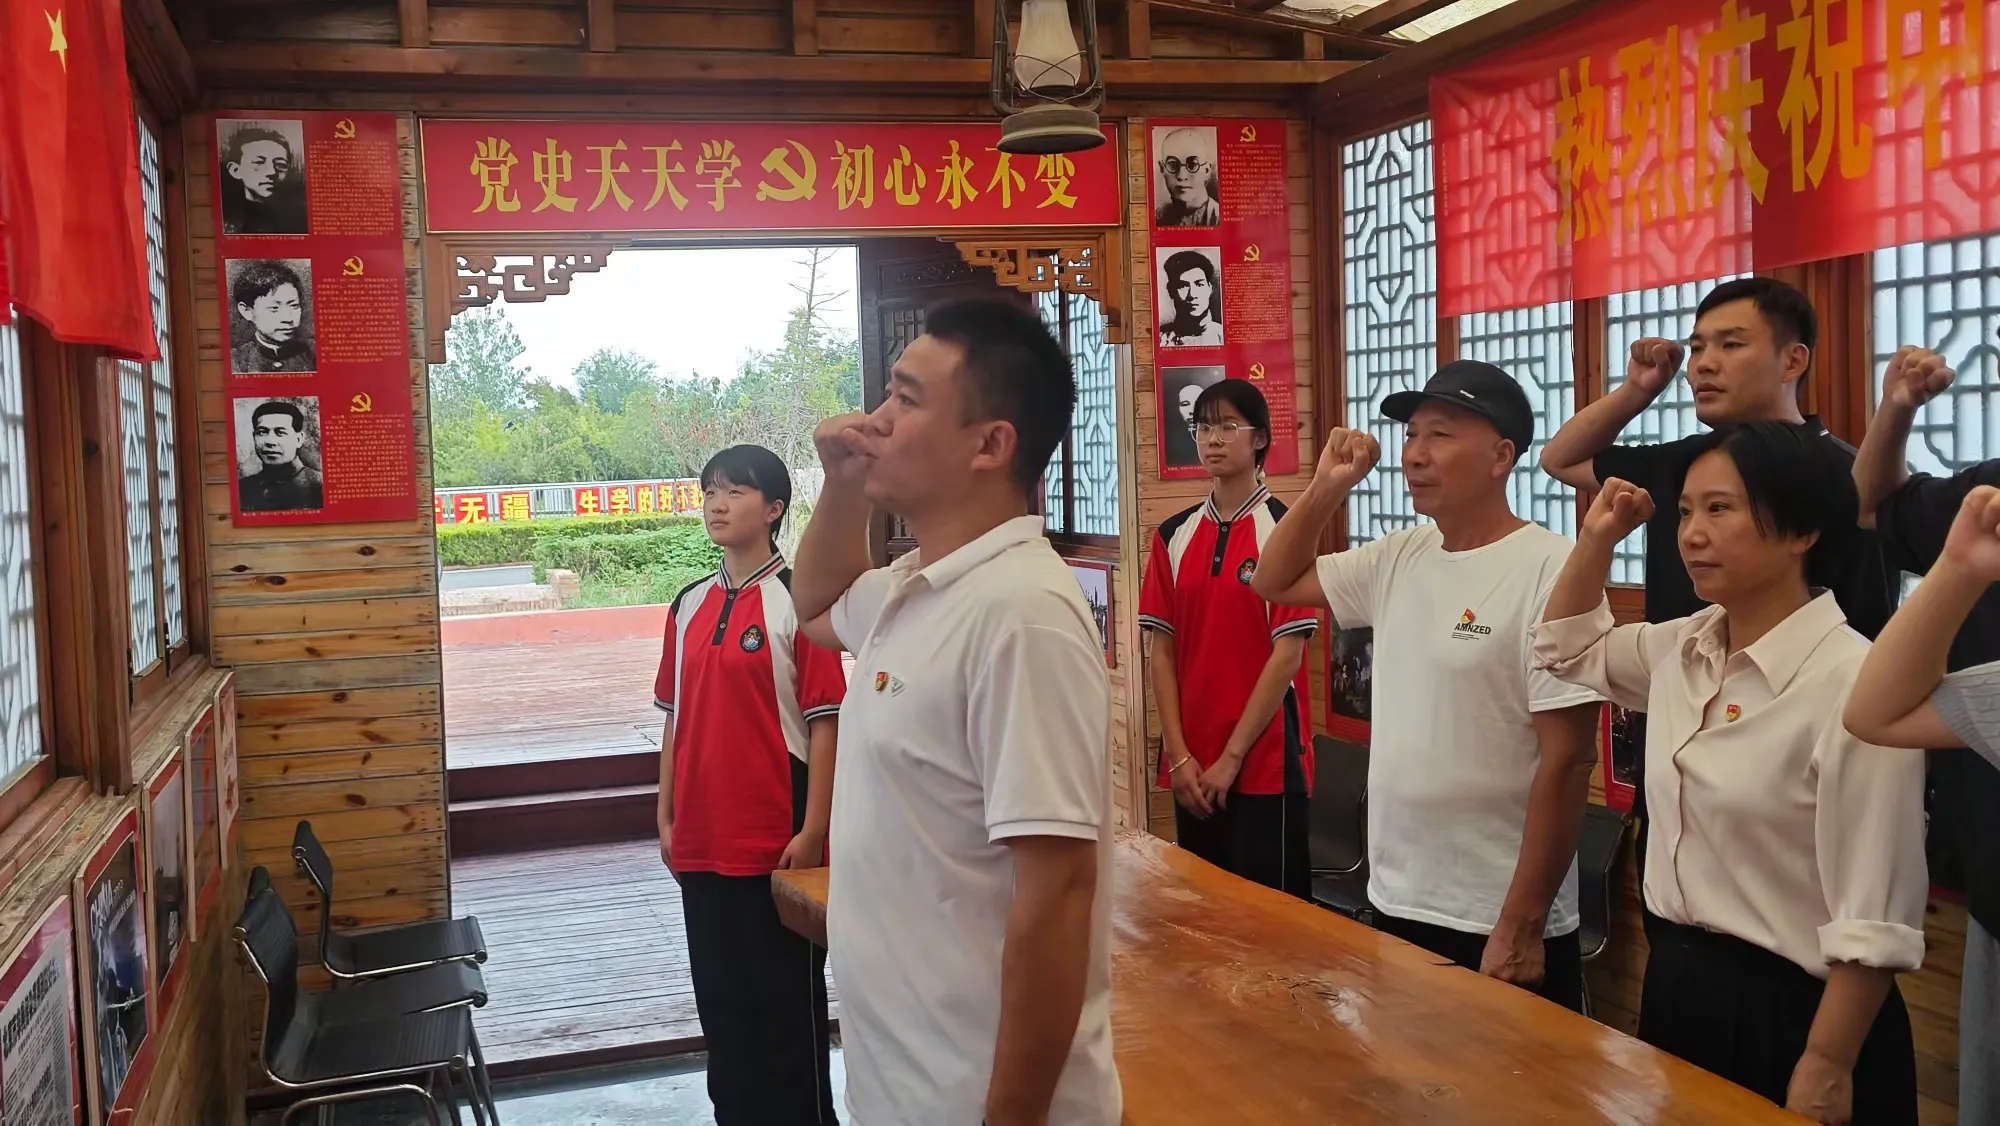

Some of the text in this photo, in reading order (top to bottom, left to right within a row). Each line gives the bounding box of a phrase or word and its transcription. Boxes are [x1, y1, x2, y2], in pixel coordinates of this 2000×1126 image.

[1551, 0, 1983, 246] 热烈庆祝中
[470, 136, 742, 213] 党史天天学
[830, 139, 1078, 210] 初心永不变
[435, 493, 529, 525] 无疆
[1454, 622, 1492, 635] AMNZED
